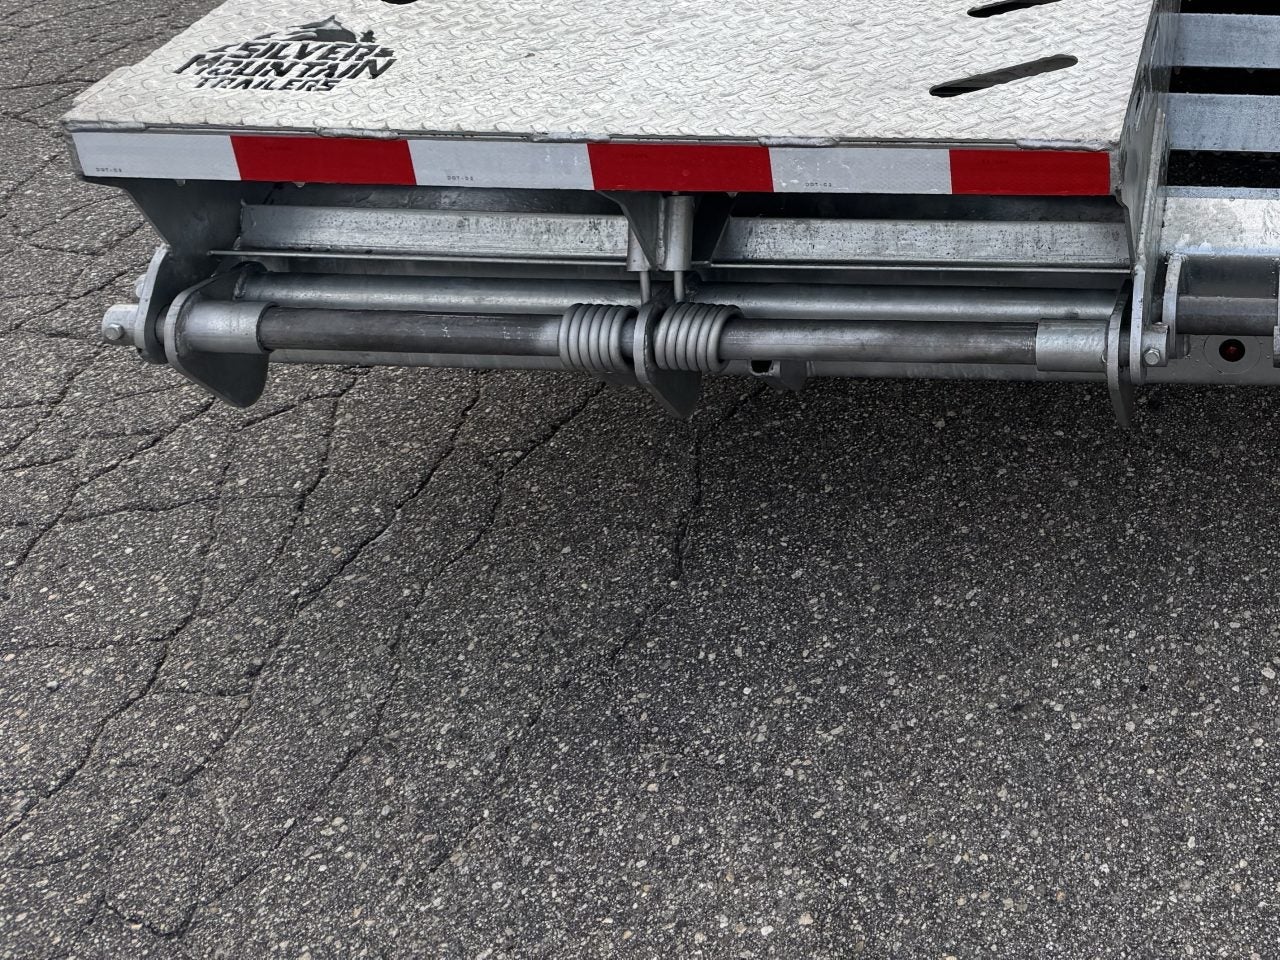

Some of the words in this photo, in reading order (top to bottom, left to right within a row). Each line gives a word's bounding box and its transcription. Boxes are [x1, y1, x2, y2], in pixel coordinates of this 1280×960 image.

[227, 42, 381, 61] SILVER
[173, 54, 397, 80] MOUNTAIN
[195, 77, 345, 91] TRAILERS
